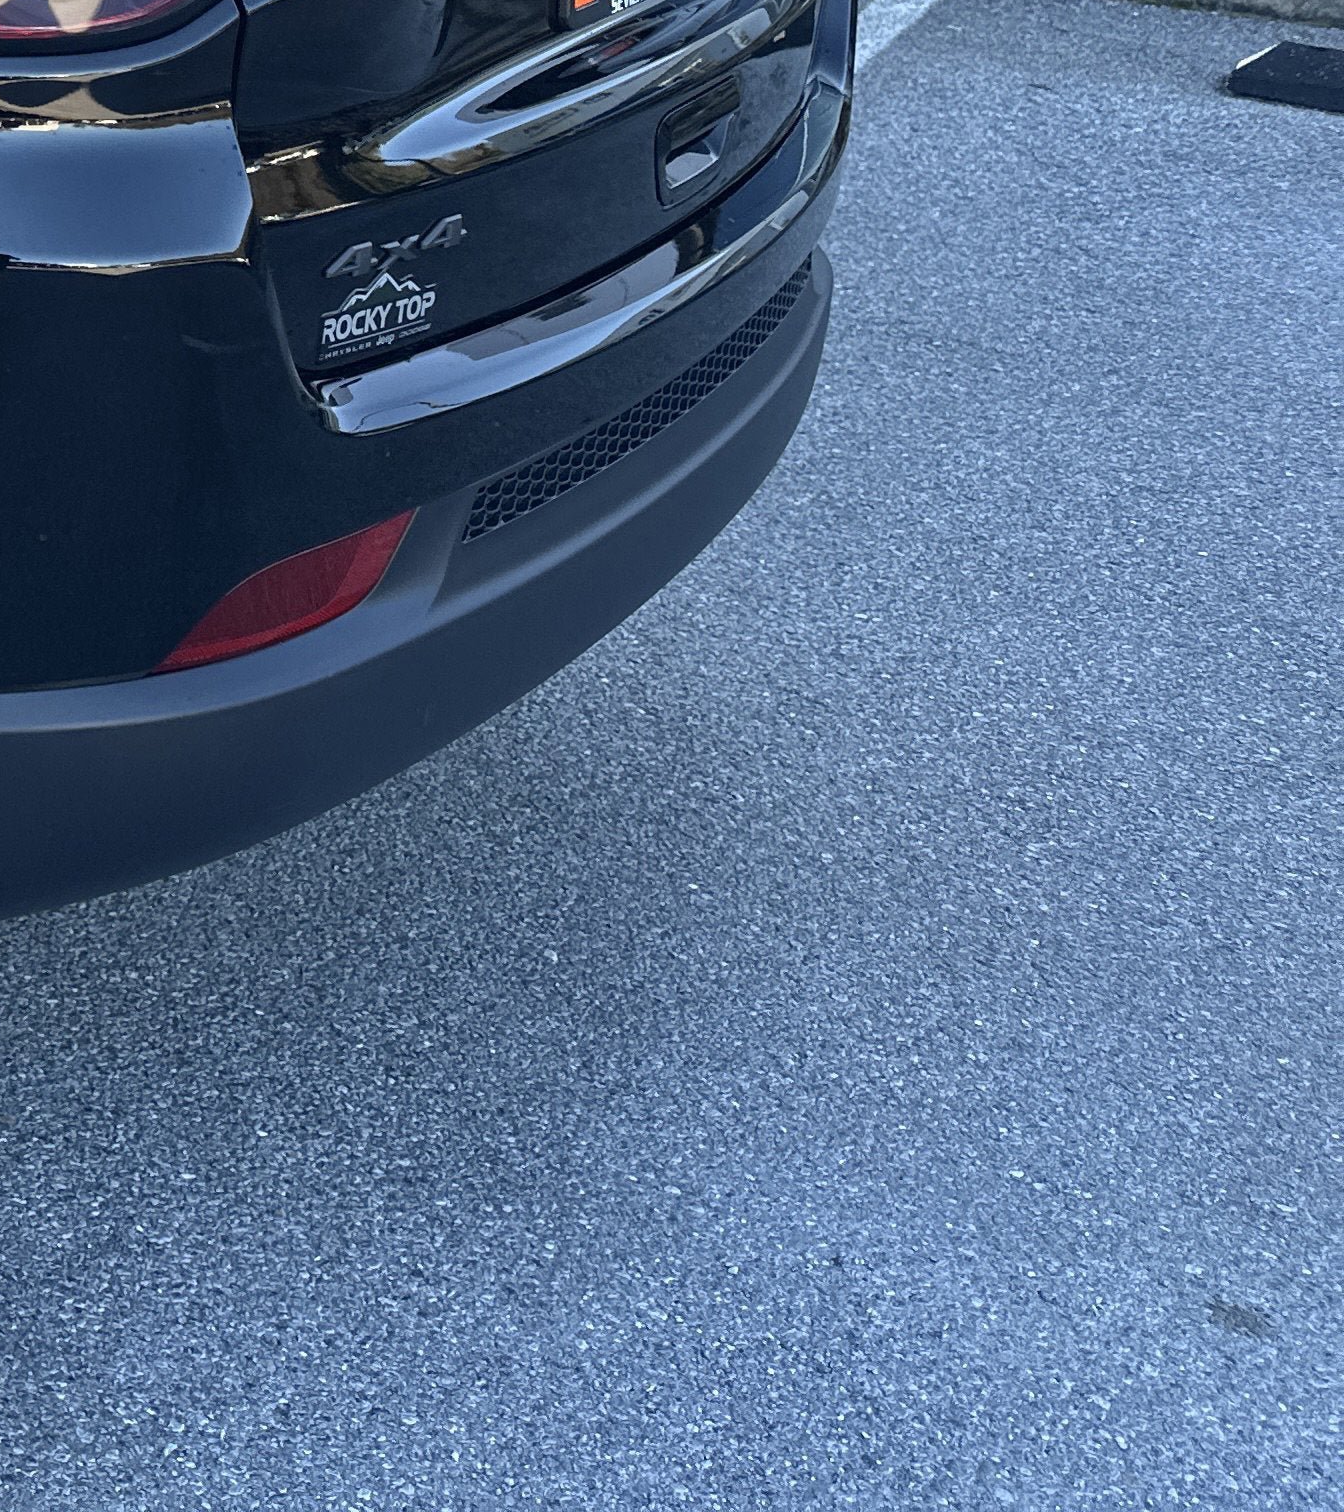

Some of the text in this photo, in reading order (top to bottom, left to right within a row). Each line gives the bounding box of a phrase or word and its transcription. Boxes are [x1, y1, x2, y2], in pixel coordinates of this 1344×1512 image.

[324, 214, 467, 278] 4x4
[322, 291, 436, 345] ROCKY TOP
[319, 341, 372, 361] CHRYSLER
